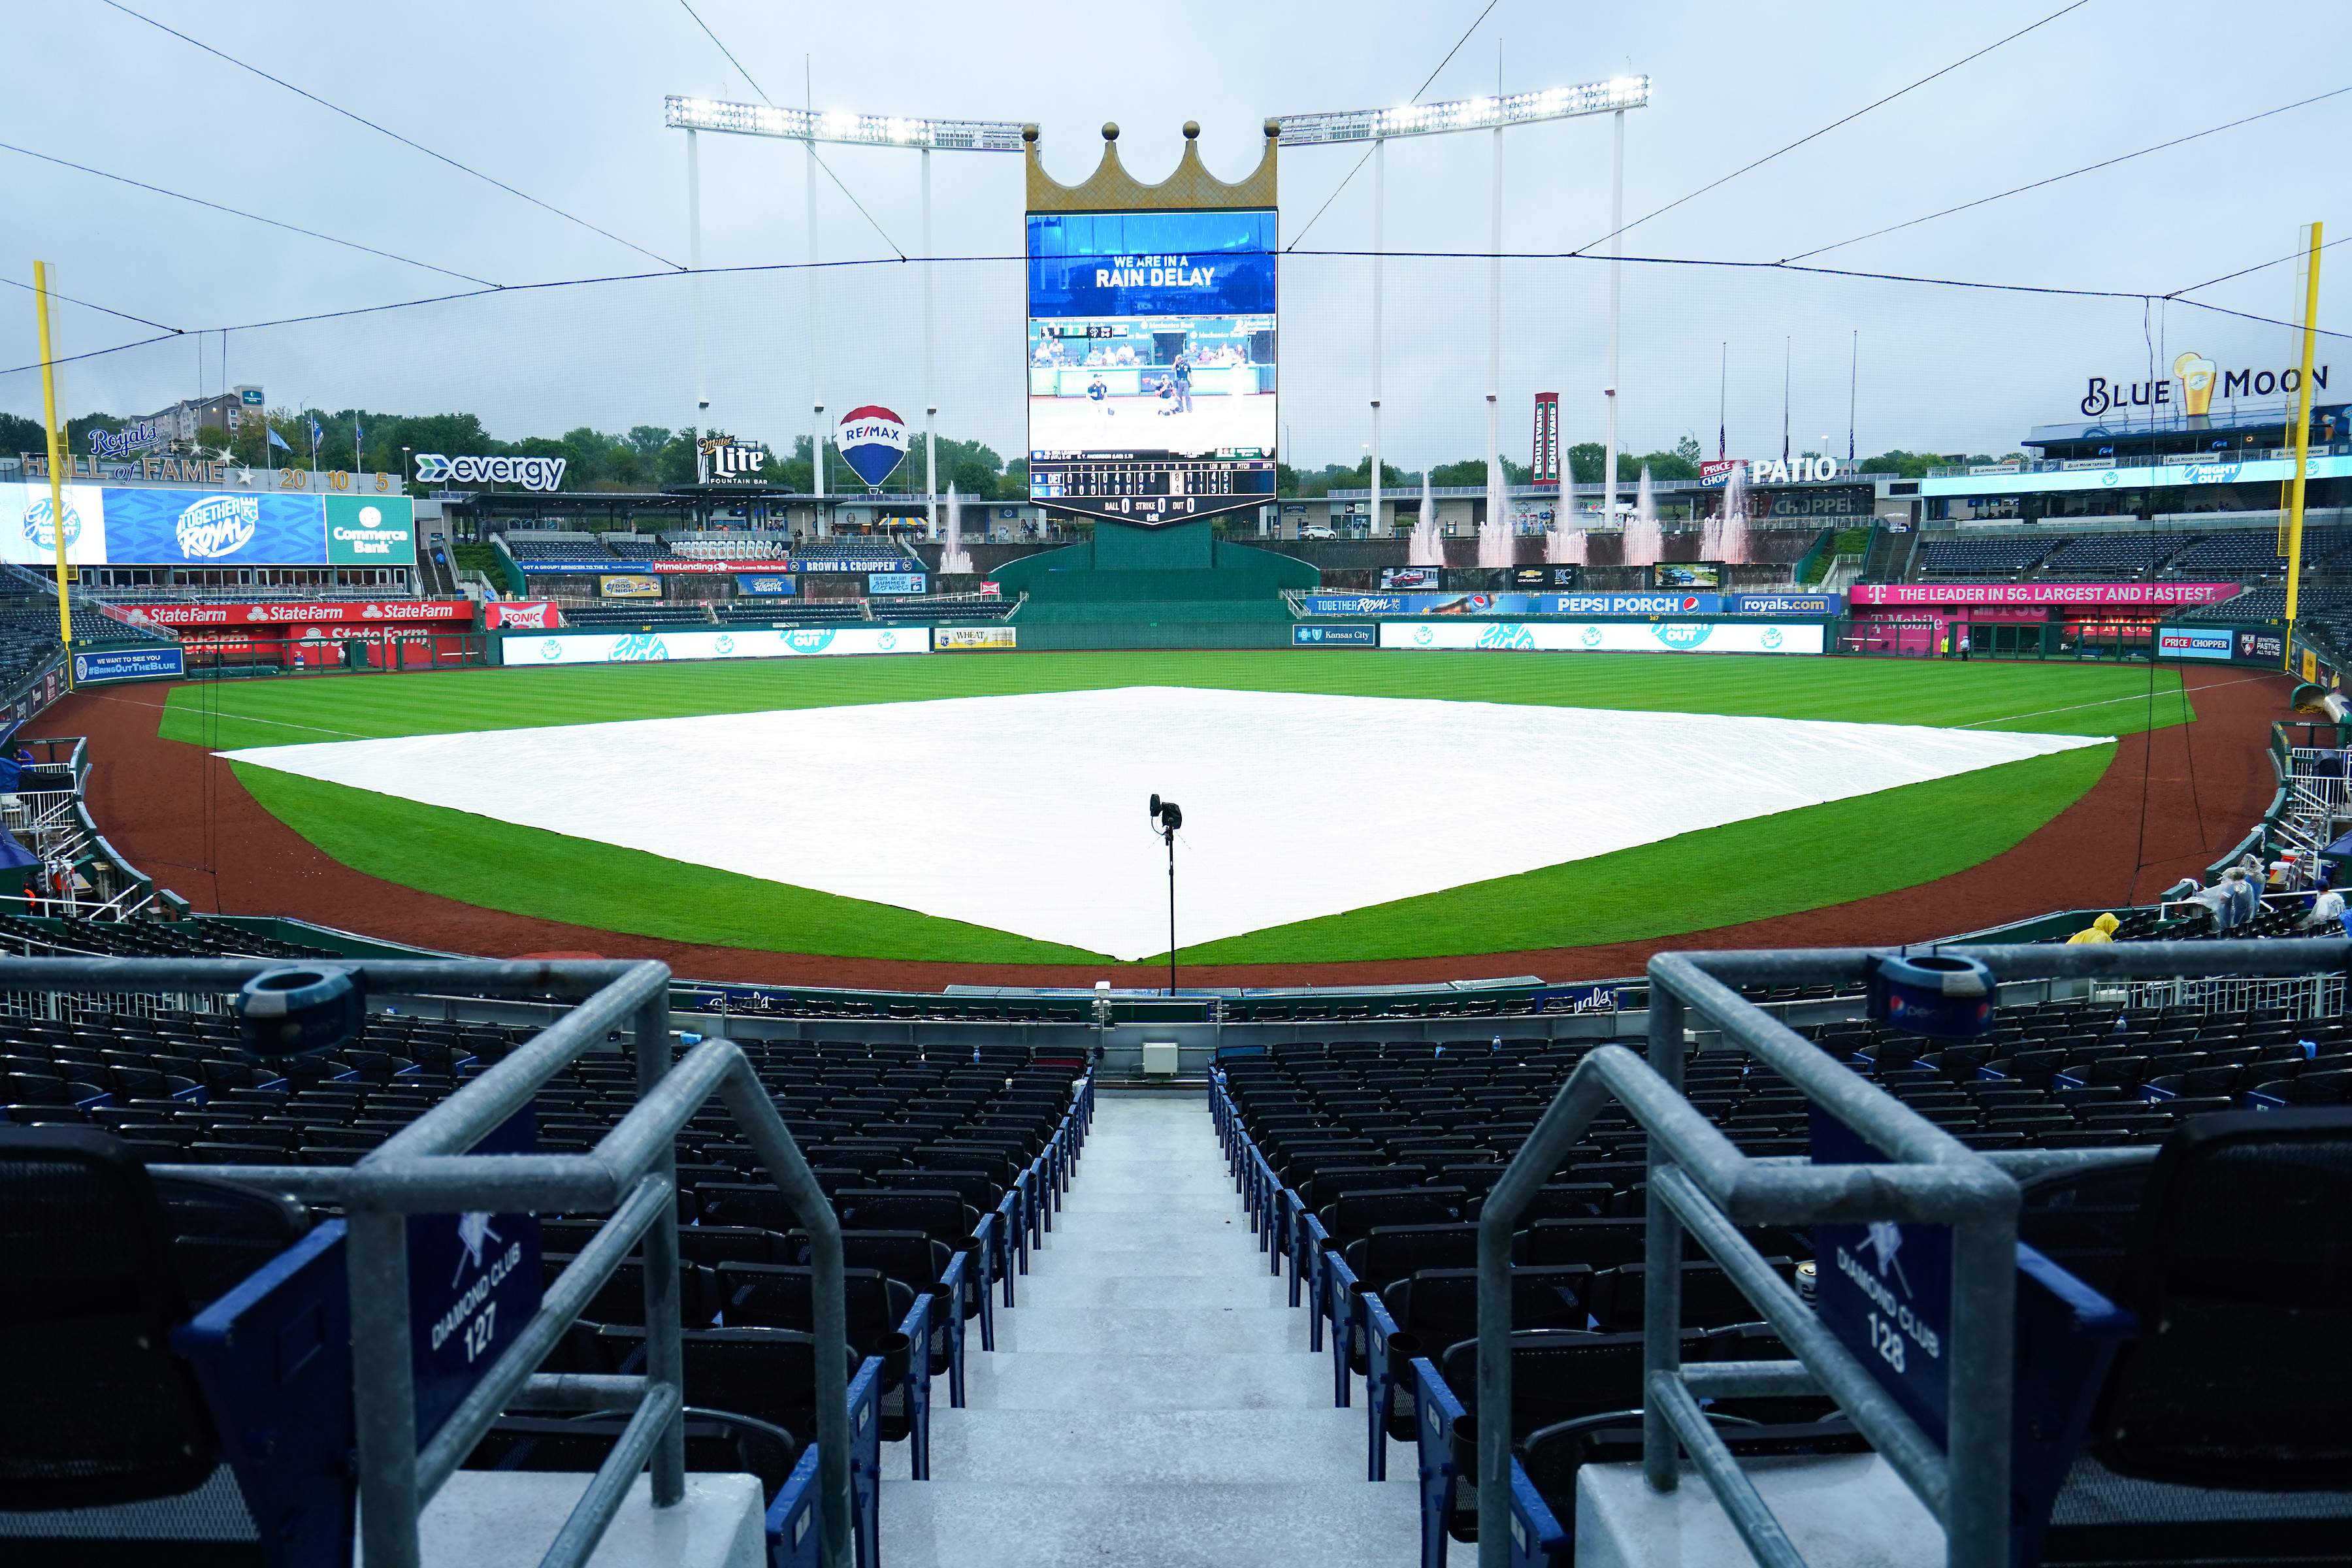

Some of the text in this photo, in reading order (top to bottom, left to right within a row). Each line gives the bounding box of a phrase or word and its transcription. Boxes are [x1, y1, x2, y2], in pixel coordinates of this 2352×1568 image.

[1114, 255, 1188, 268] WE ARE IN A
[1096, 268, 1215, 287] RAIN DELAY
[2082, 366, 2327, 416] BLUE MOON
[88, 422, 159, 457] Royals
[847, 426, 898, 441] RE/MAX
[1535, 408, 1543, 474] BOULEVARD
[698, 436, 734, 455] Miller
[714, 446, 764, 478] Lite
[1703, 461, 1730, 475] PRICE
[114, 460, 140, 485] of
[142, 457, 226, 483] FAME
[454, 457, 563, 487] evergy
[1753, 457, 1837, 483] PATIO
[2198, 465, 2238, 475] NIGHT
[279, 468, 389, 491] 20 10 5
[1048, 474, 1062, 484] DET
[1068, 474, 1072, 483] 0
[1079, 474, 1083, 483] 1
[1091, 474, 1096, 483] 3
[1103, 474, 1107, 483] 0
[1115, 473, 1119, 483] 4
[1126, 473, 1131, 483] 0
[1139, 473, 1143, 483] 0
[1151, 473, 1155, 482] 0
[1186, 472, 1192, 482] 11
[1200, 472, 1203, 482] 1
[1211, 472, 1217, 482] 4
[1224, 472, 1228, 482] 5
[1068, 485, 1071, 495] 1
[1079, 485, 1084, 495] 0
[1091, 485, 1096, 495] 0
[1103, 485, 1107, 495] 1
[1115, 485, 1120, 495] 0
[1126, 485, 1131, 495] 0
[1139, 484, 1143, 494] 2
[1187, 484, 1192, 493] 4
[1200, 484, 1203, 493] 1
[1211, 484, 1217, 493] 3
[1224, 483, 1228, 493] 5
[1122, 498, 1130, 513] 0
[1158, 498, 1166, 513] 0
[1187, 498, 1194, 513] 0
[178, 497, 240, 530] TOGETHER
[178, 514, 254, 559] ROYAL
[333, 527, 408, 541] Commerce
[353, 541, 391, 553] Bank
[655, 563, 713, 572] PrimeLending
[807, 561, 838, 571] BROWN
[840, 561, 848, 571] &
[1898, 589, 1926, 600] THE
[1929, 589, 1984, 600] LEADER
[1988, 589, 2002, 600] IN
[2007, 588, 2031, 600] 5G.
[2034, 588, 2103, 600] LARGEST
[2106, 588, 2141, 600] AND
[2146, 587, 2215, 600] FASTEST.
[1317, 600, 1358, 610] TOGETHER
[1357, 598, 1392, 612] ROYAL
[1558, 598, 1678, 612] PEPSI PORCH
[1745, 598, 1824, 612] royals.com
[505, 613, 540, 622] SONIC
[1887, 614, 1943, 630] Mobile
[794, 636, 821, 647] OUT
[1354, 631, 1369, 640] City
[1666, 630, 1697, 641] OUT
[2164, 638, 2227, 649] PRICE CHOPPER
[433, 1241, 521, 1350] DIAMOND CLUB
[1837, 1246, 1940, 1358] DIAMOND CLUB
[464, 1301, 497, 1364] 127
[1869, 1313, 1905, 1373] 128
